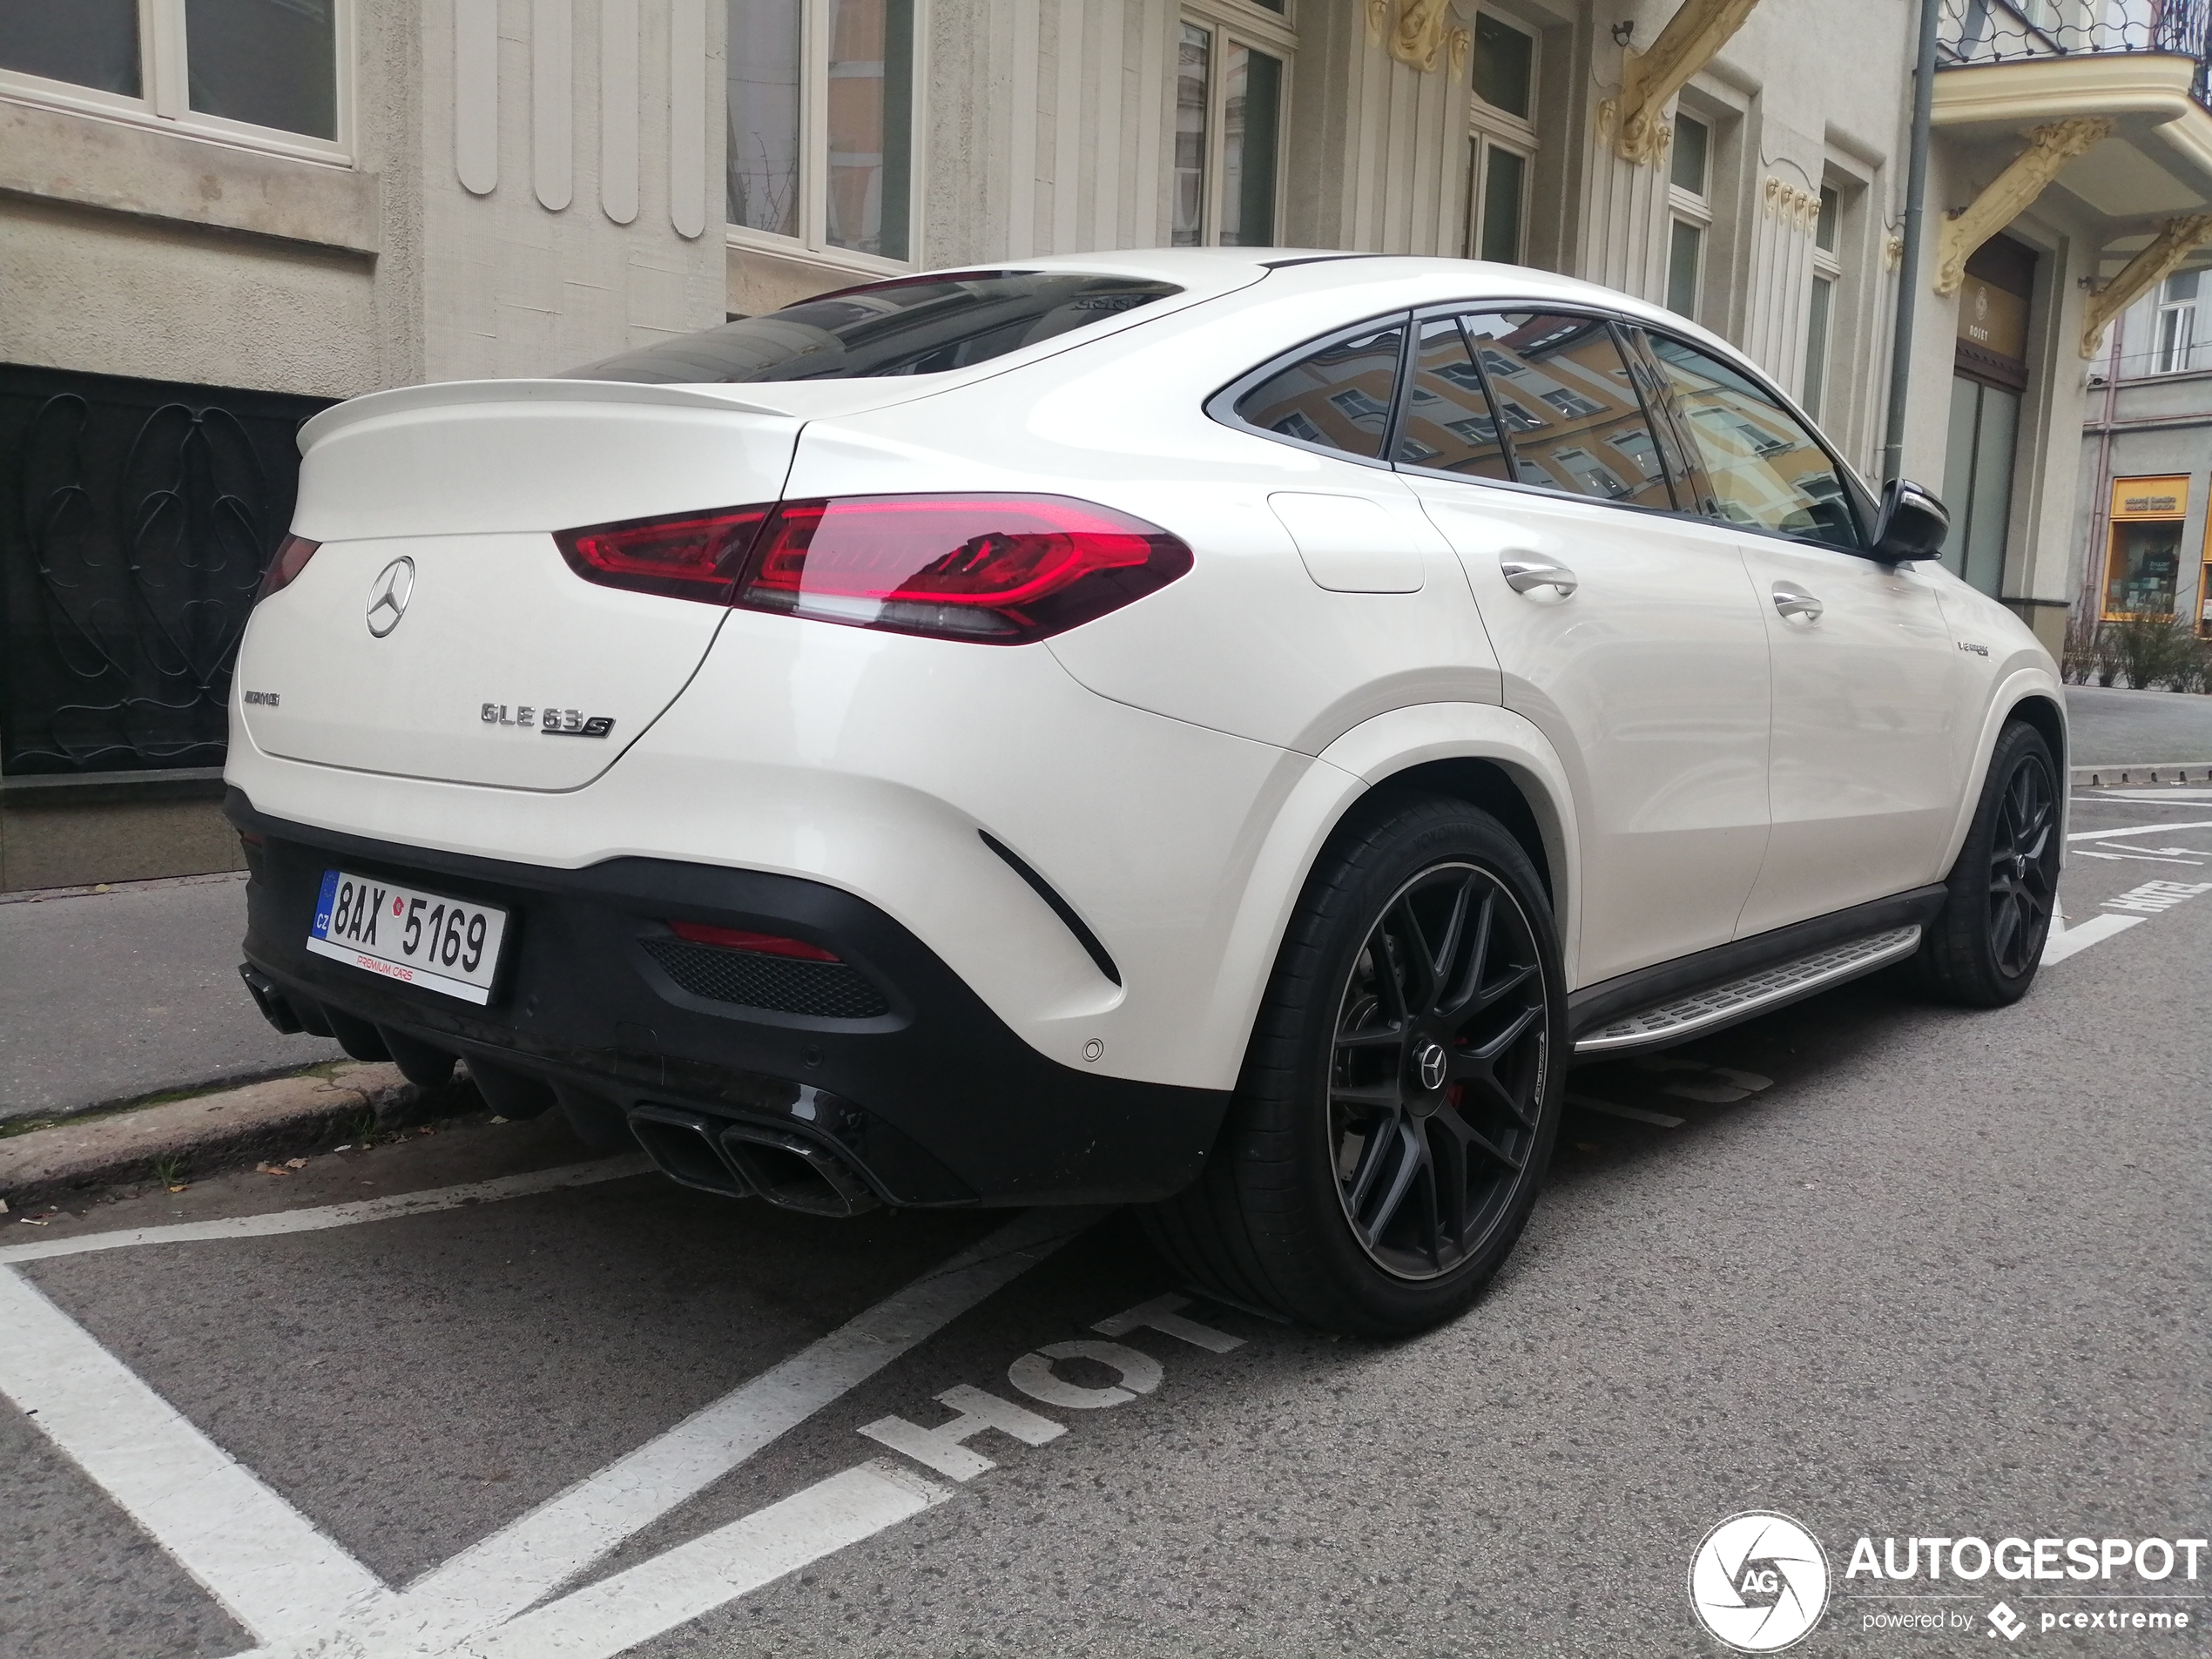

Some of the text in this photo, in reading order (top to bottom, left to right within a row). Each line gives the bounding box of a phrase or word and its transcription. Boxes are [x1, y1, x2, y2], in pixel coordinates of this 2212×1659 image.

[1969, 325, 1988, 341] ROSET
[247, 691, 280, 706] AMG
[480, 702, 536, 727] GLE
[316, 913, 329, 931] CZ
[334, 881, 487, 973] 8AX 5169
[356, 955, 414, 981] PREMIUM CARS
[856, 1284, 1294, 1482] HOT
